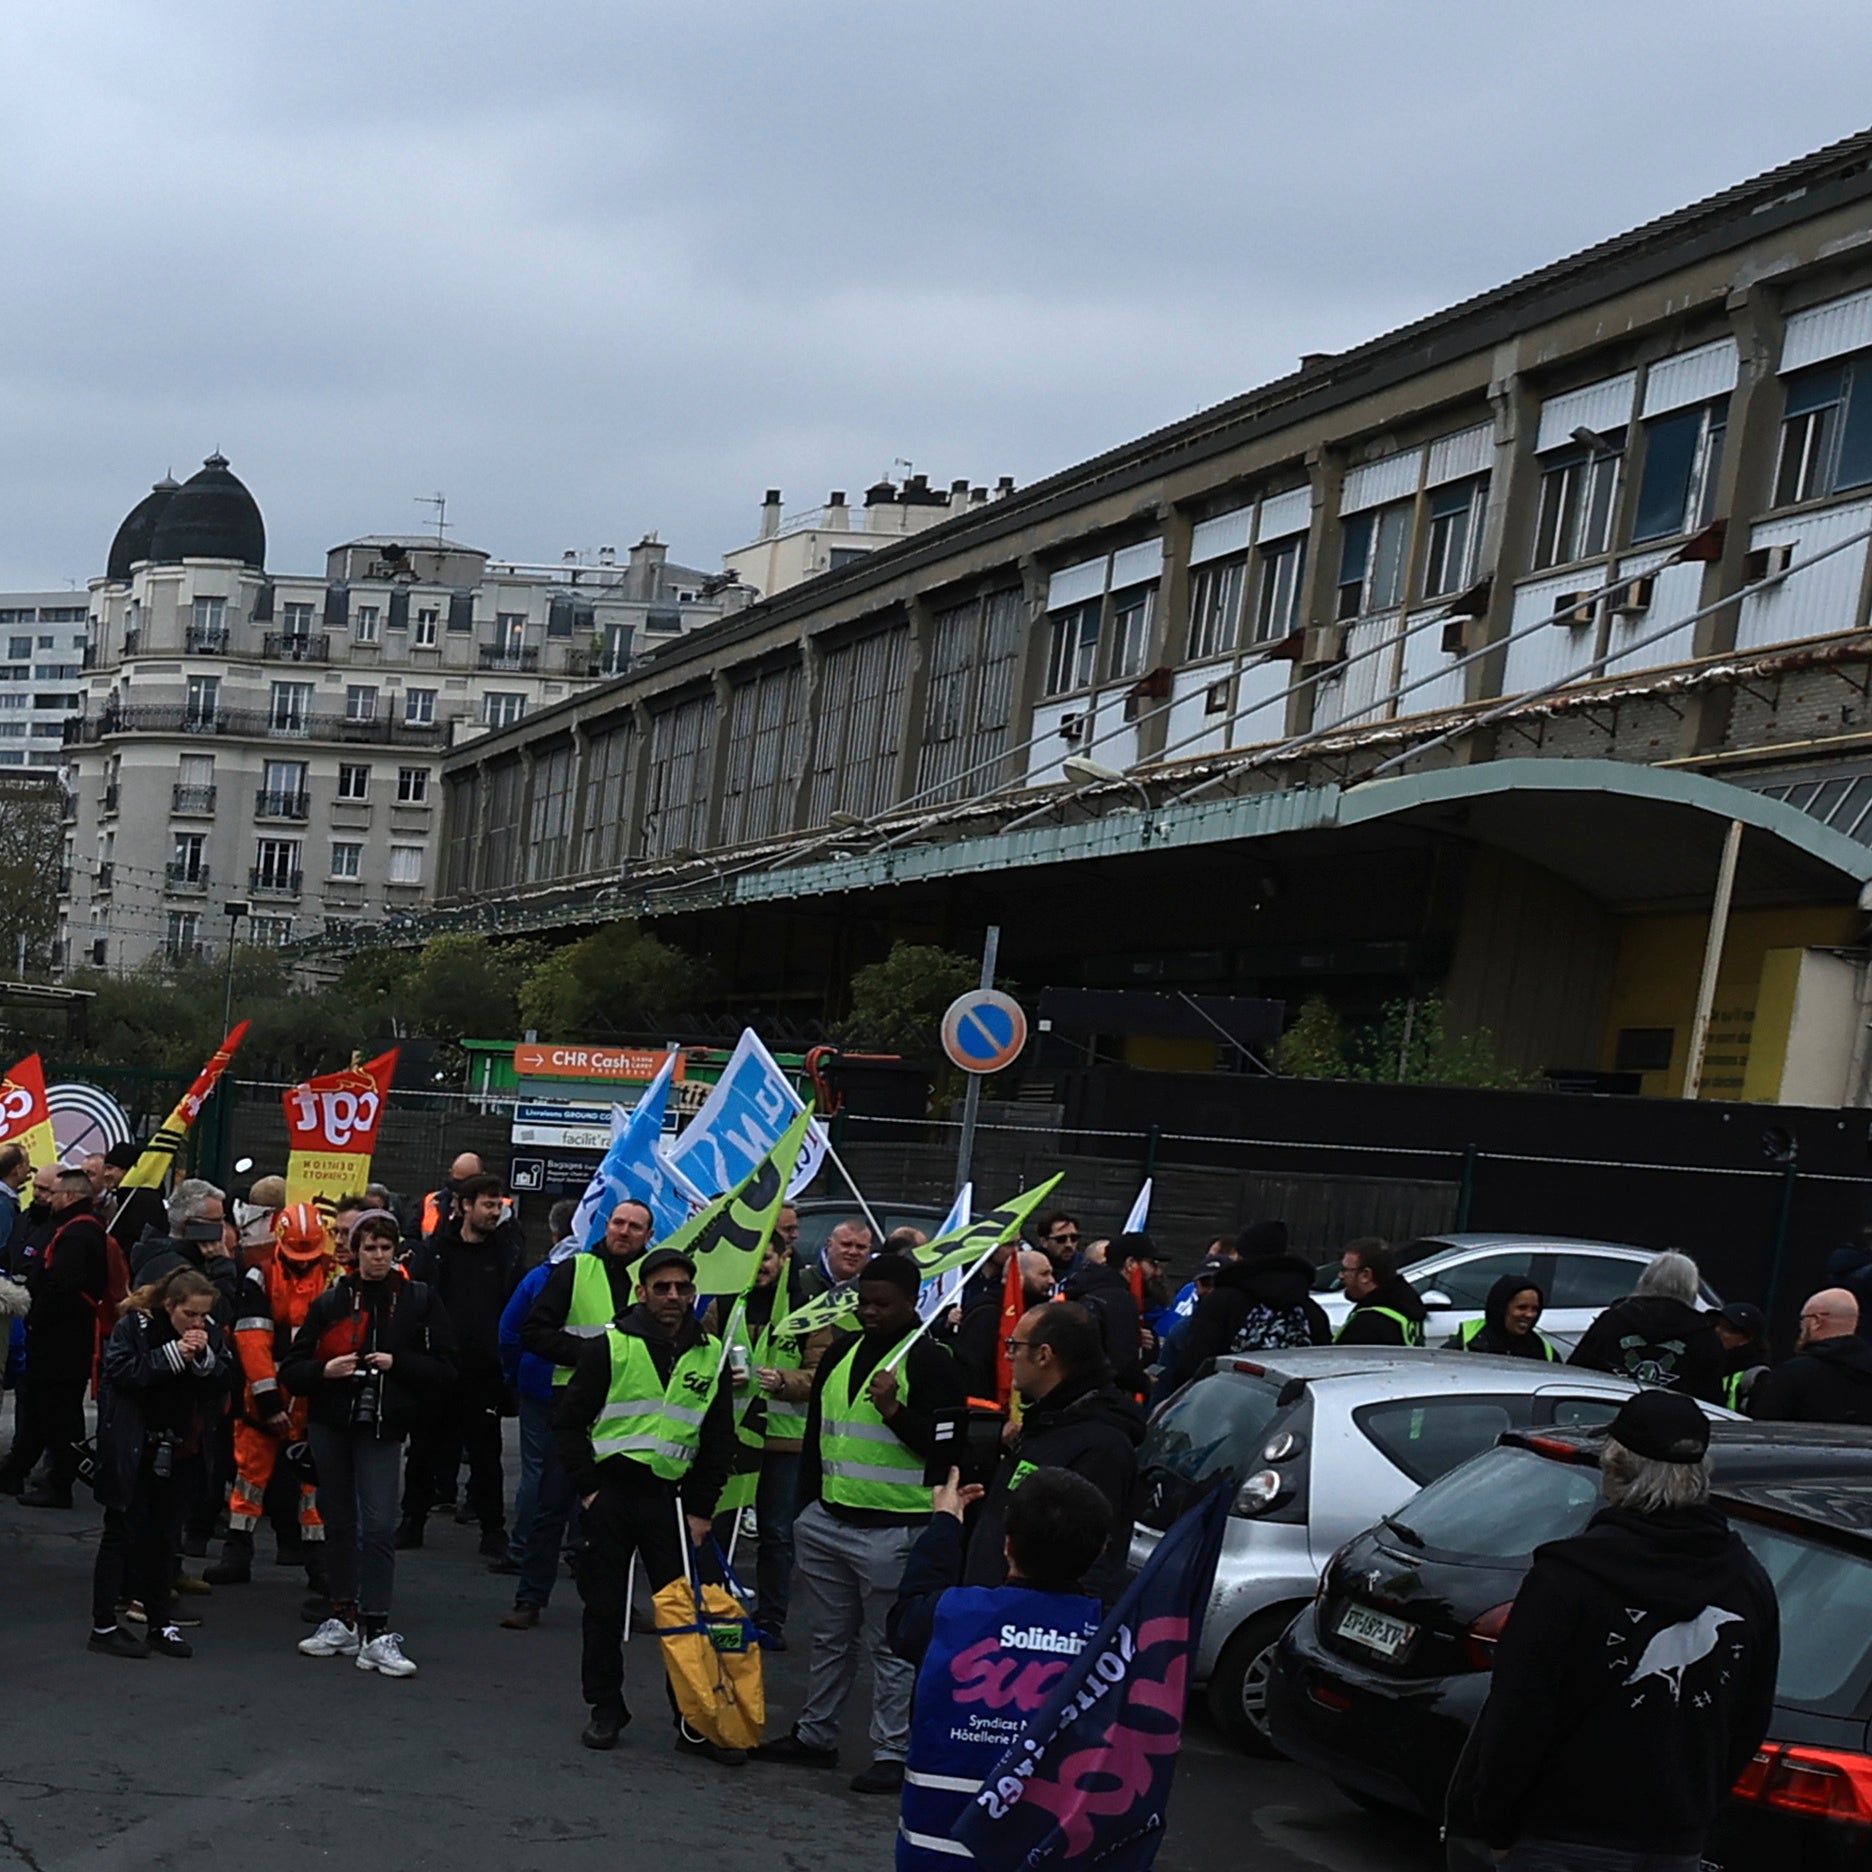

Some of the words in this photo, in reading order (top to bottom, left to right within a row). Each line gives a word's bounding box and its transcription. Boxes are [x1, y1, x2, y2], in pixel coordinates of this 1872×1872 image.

[552, 1051, 587, 1067] CHR
[591, 1053, 630, 1069] Cash
[564, 1111, 598, 1120] GROUND
[1000, 1624, 1090, 1656] Solidair
[969, 1714, 1019, 1731] Syndicat
[950, 1728, 1010, 1745] Hôtellerie
